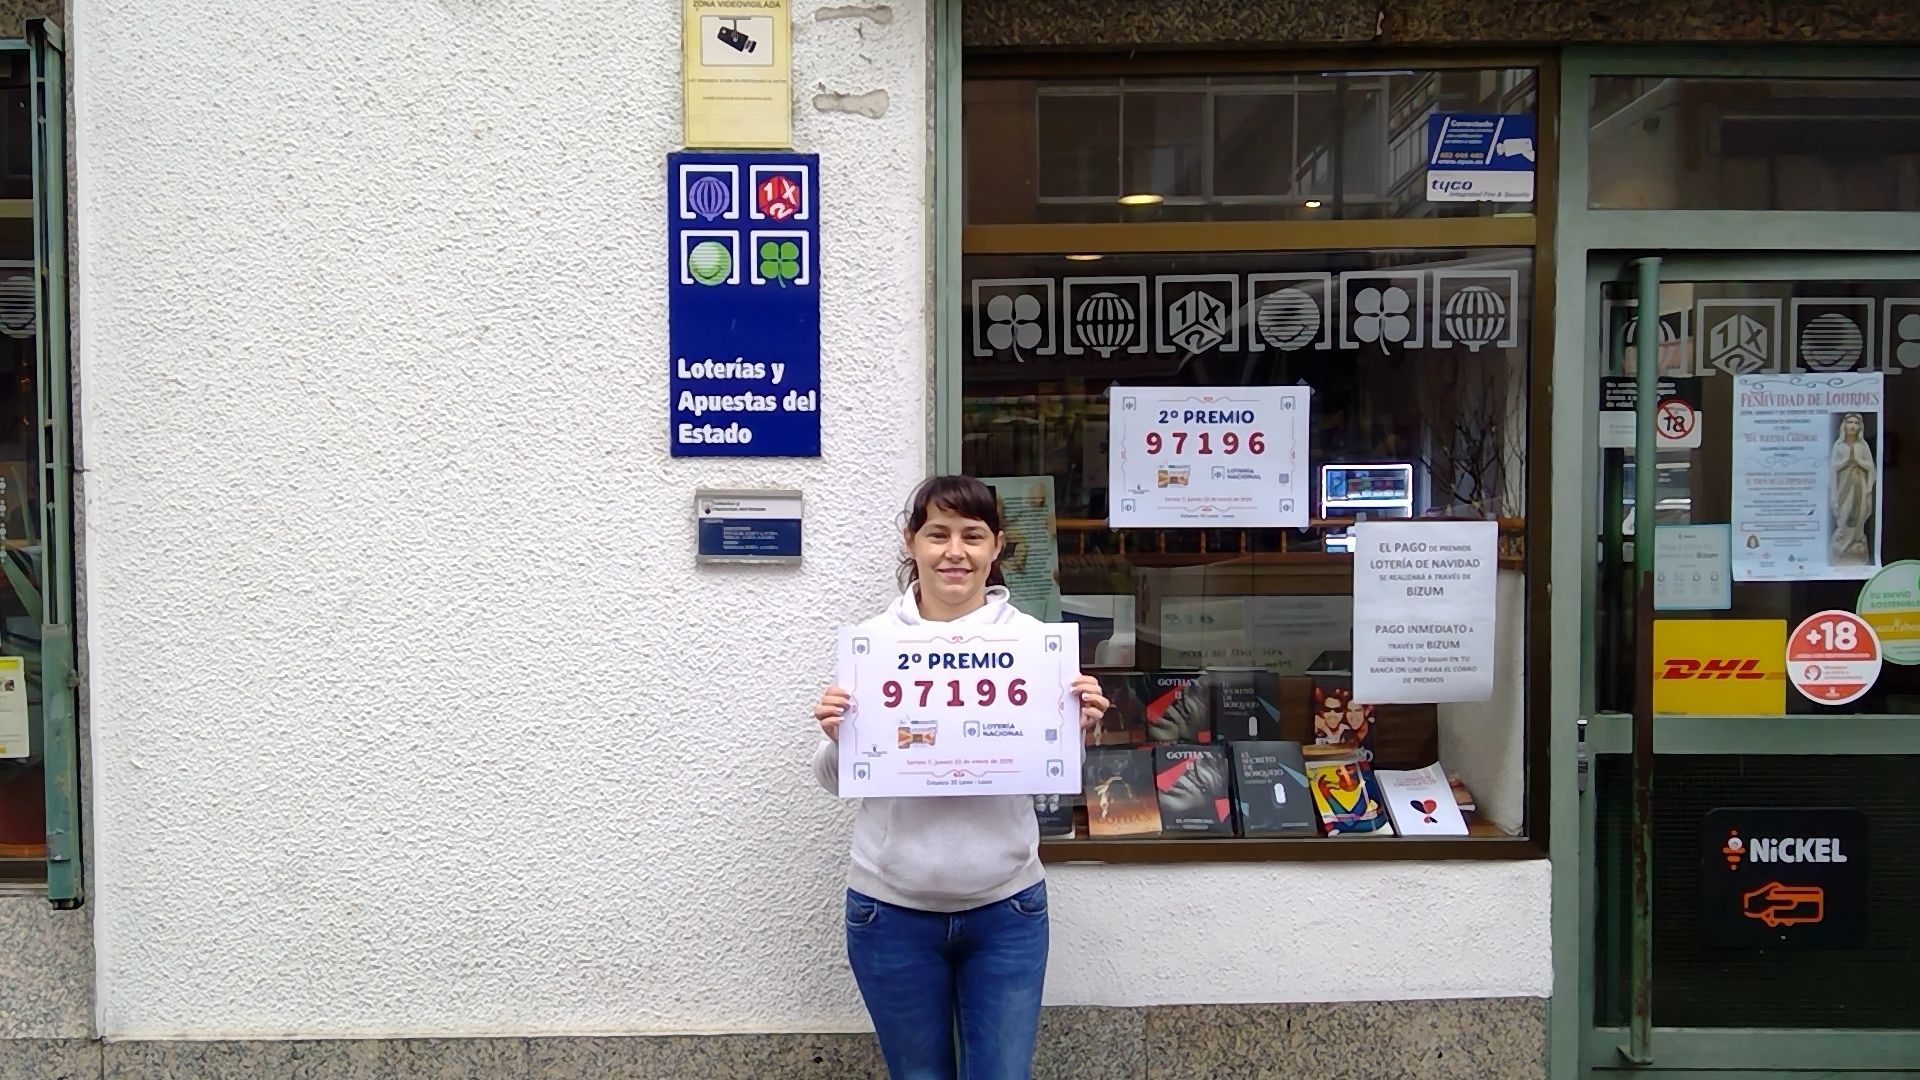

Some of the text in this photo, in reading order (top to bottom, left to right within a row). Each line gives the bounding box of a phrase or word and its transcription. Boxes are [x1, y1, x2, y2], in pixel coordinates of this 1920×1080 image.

[693, 0, 715, 8] ZONA
[1432, 180, 1473, 193] tyco
[678, 357, 785, 384] Loterías y
[678, 391, 816, 416] Apuestas del
[1808, 392, 1824, 407] DE
[1826, 390, 1880, 407] LOURDES
[1158, 410, 1255, 424] 2º PREMIO
[679, 422, 752, 444] Estado
[1379, 543, 1391, 552] EL
[1395, 542, 1427, 552] PAGO
[1370, 557, 1480, 569] LOTERÍA DE NAVIDAD
[1406, 586, 1444, 596] BIZUM
[1375, 625, 1405, 634] PAGO
[1407, 624, 1467, 633] INMEDIATO
[1806, 621, 1858, 651] +18
[1427, 640, 1460, 649] BIZUM
[898, 652, 1014, 670] 2º PREMIO
[1662, 659, 1767, 680] DHL
